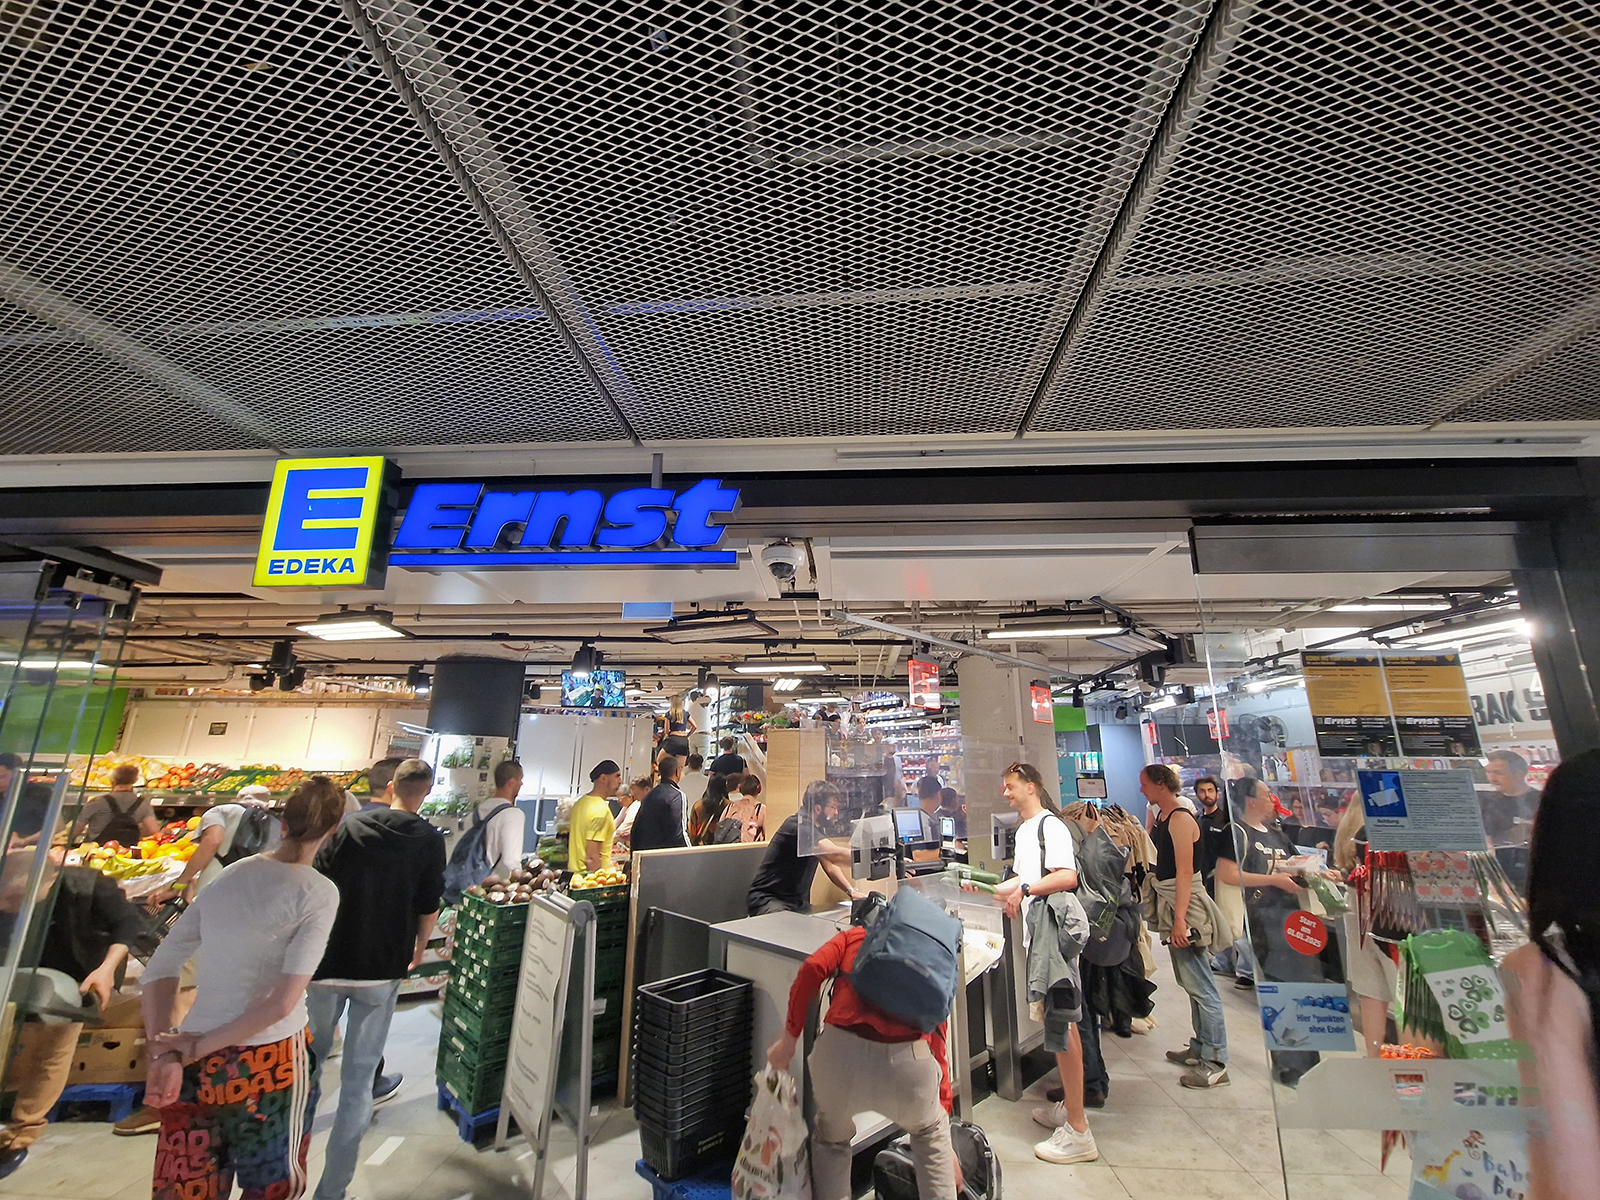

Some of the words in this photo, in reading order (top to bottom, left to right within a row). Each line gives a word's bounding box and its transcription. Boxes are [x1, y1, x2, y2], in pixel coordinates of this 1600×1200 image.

[393, 478, 741, 549] Ernst
[268, 557, 356, 575] EDEKA
[1323, 717, 1358, 725] Ernst
[1405, 717, 1440, 725] Ernst
[1299, 915, 1317, 928] Start
[1296, 1014, 1311, 1022] Hier
[1309, 1025, 1326, 1033] ohne
[1482, 1150, 1525, 1183] Bab
